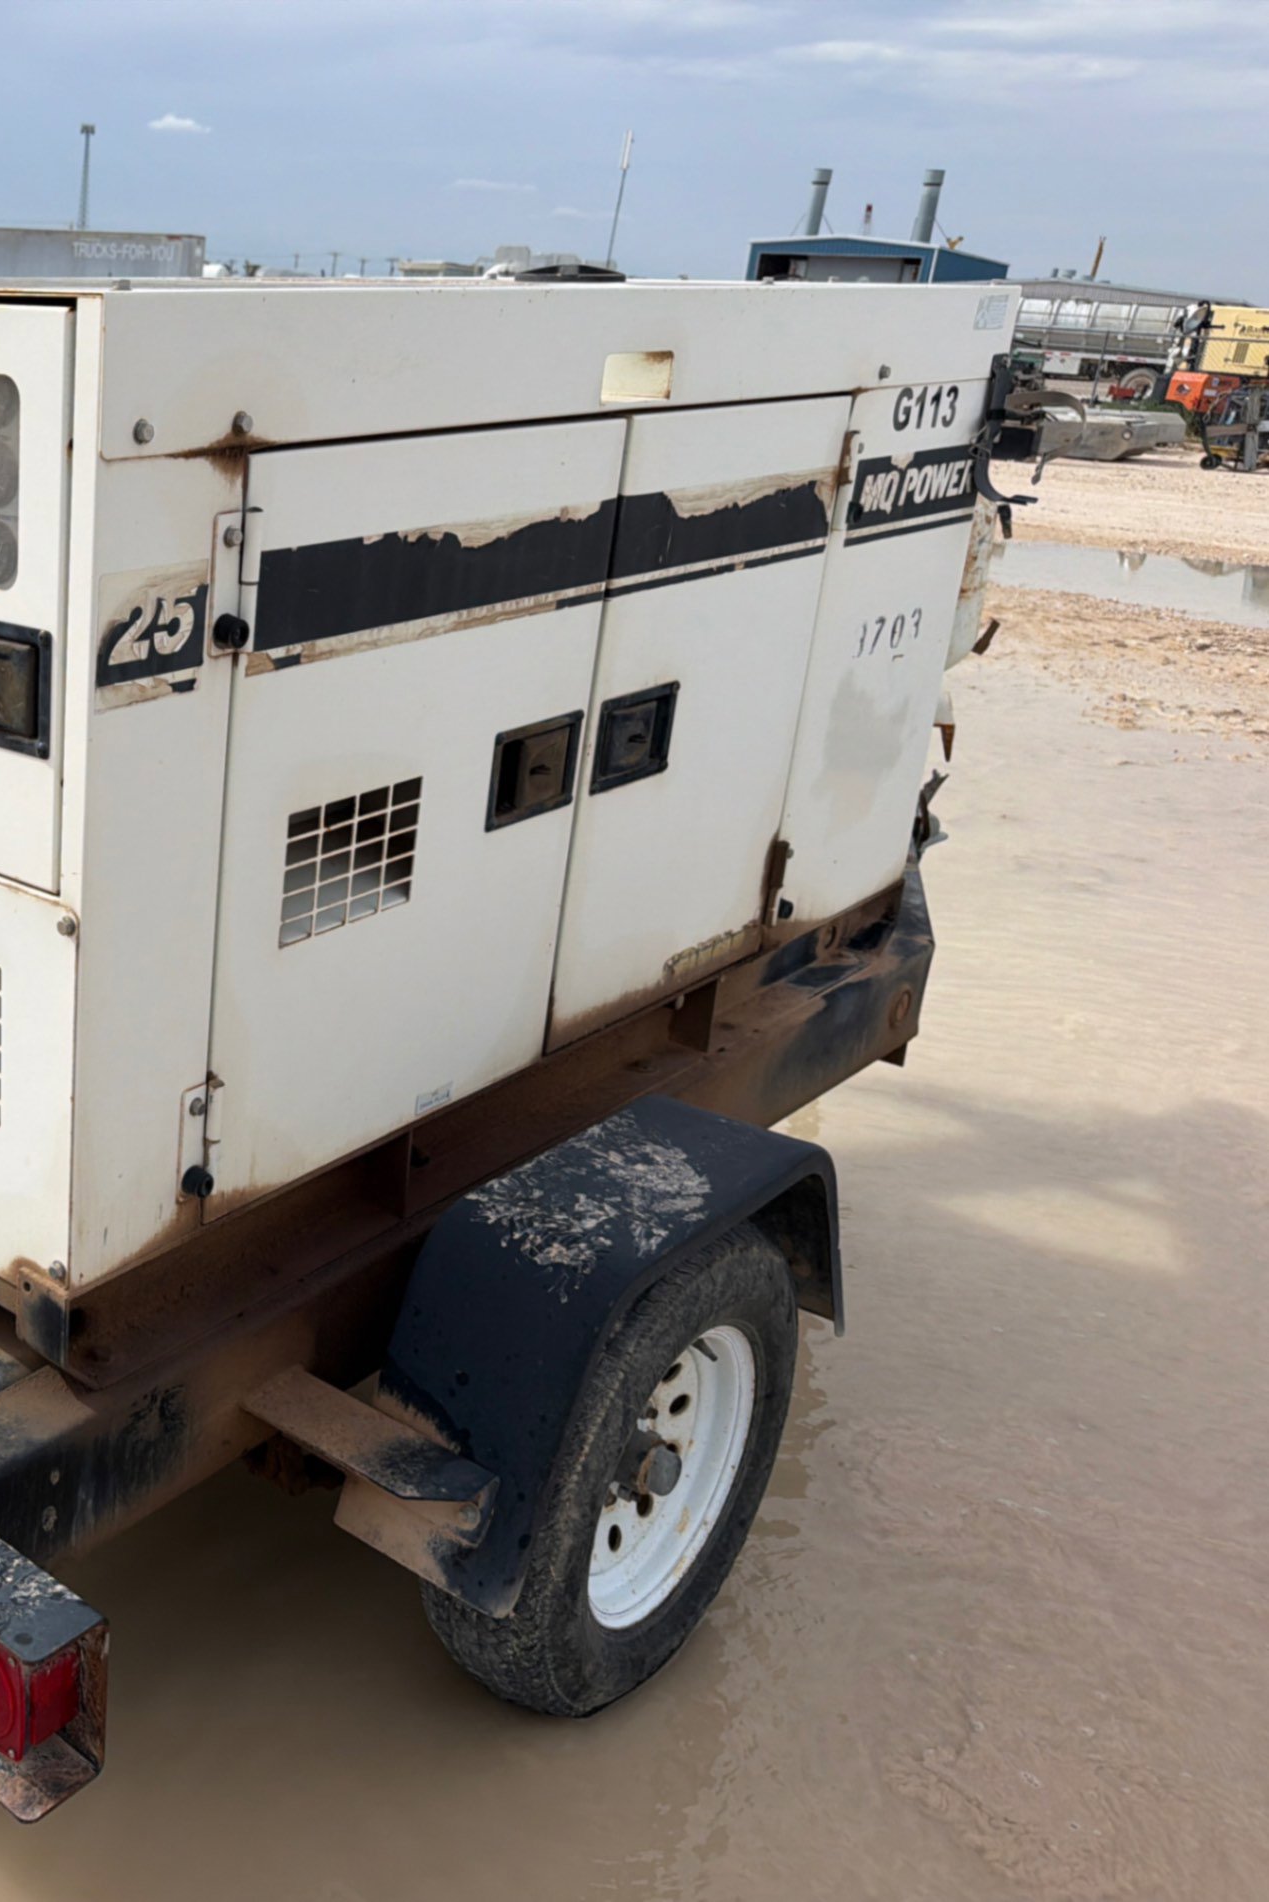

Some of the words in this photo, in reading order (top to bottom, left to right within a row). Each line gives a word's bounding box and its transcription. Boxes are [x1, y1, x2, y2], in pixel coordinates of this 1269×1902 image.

[73, 241, 175, 262] TRUCKS-FOR-YOU
[893, 385, 959, 431] G113
[860, 471, 900, 515] MQ
[897, 459, 973, 507] POWER
[108, 588, 197, 666] 25
